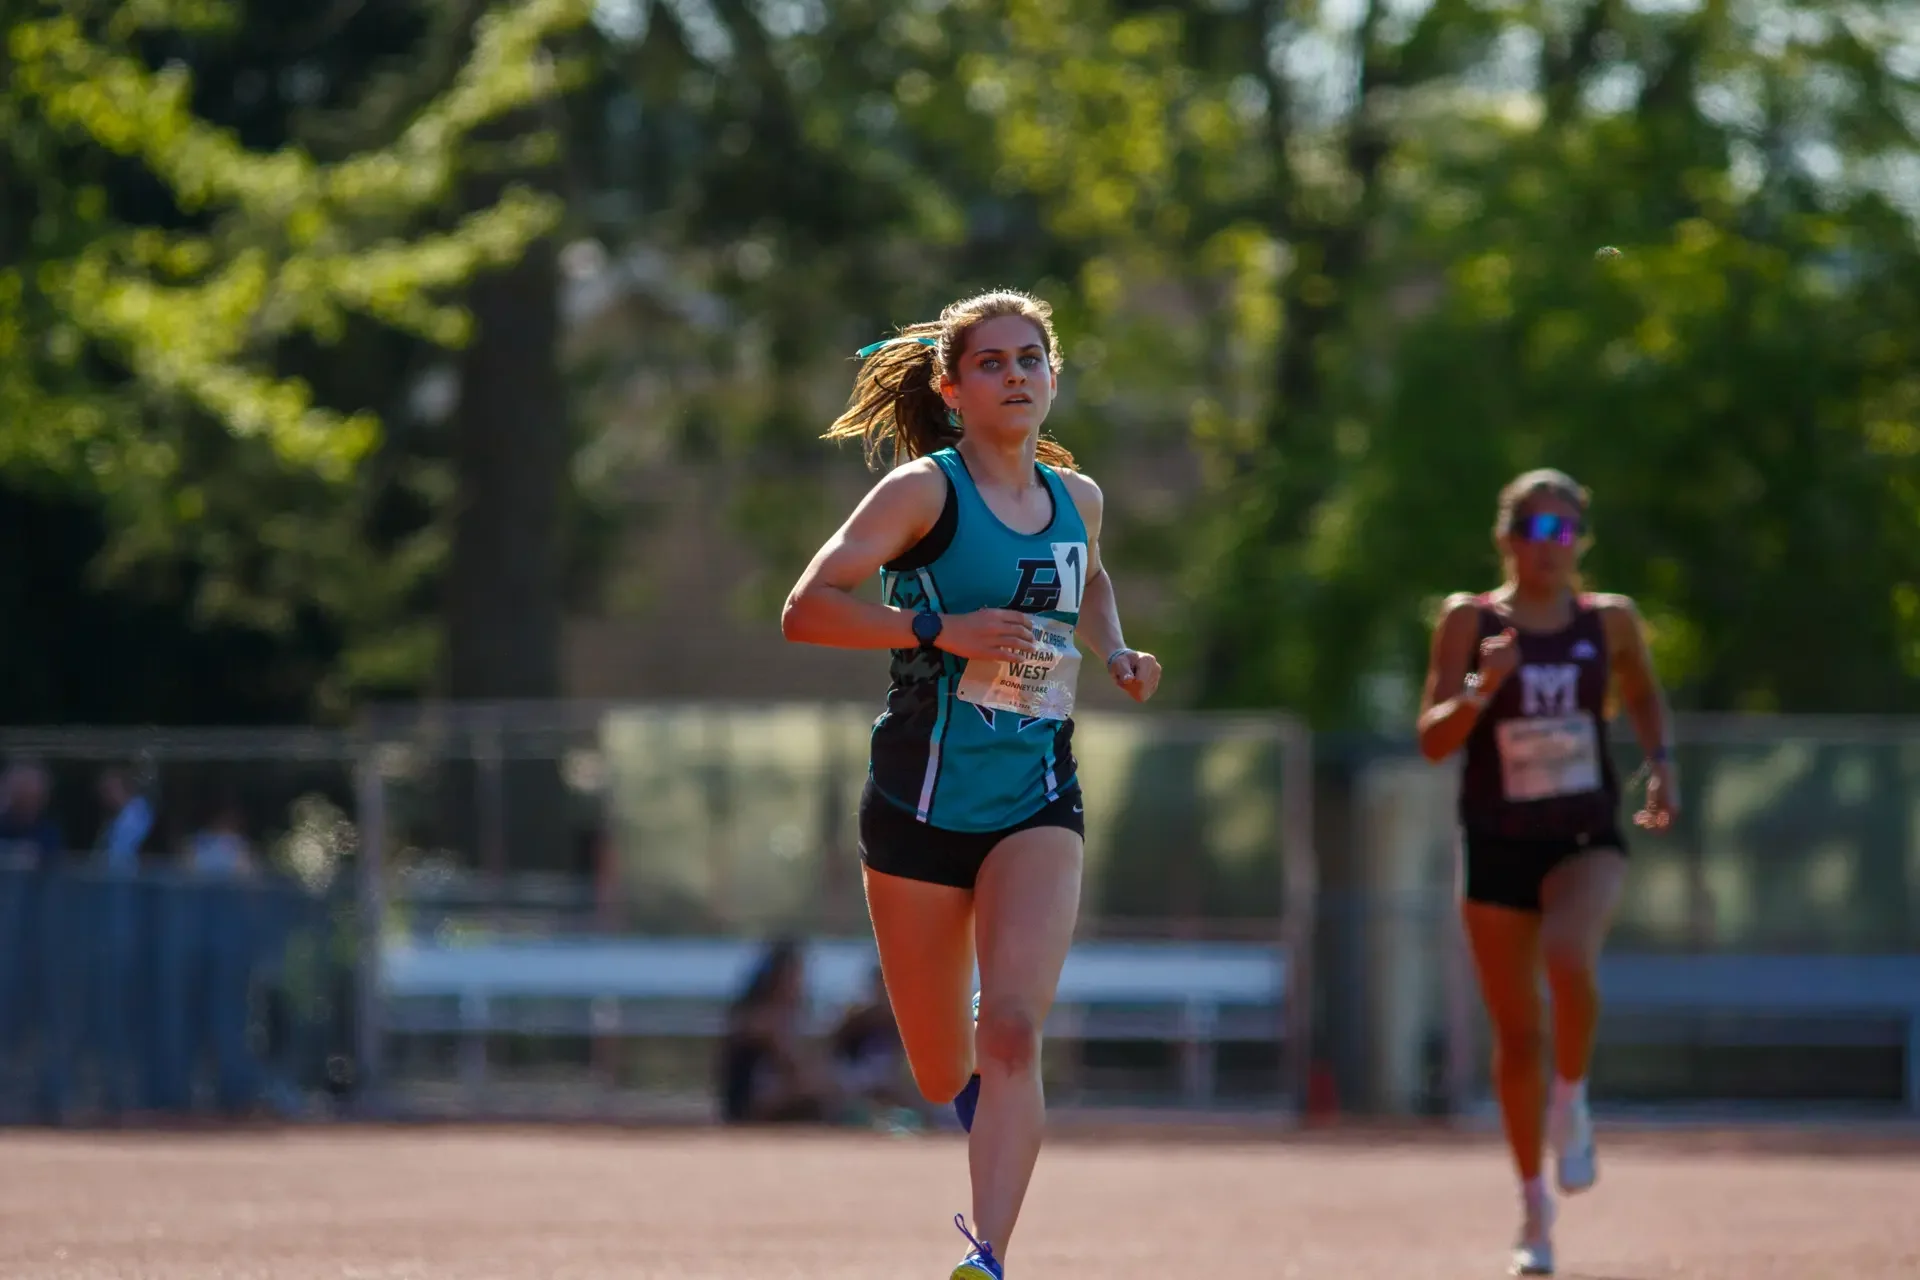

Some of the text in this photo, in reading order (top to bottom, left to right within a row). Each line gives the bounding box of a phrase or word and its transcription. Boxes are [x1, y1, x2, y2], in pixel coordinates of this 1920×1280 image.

[1065, 546, 1081, 609] 1
[1009, 661, 1050, 681] WEST
[1000, 679, 1049, 694] BONNEY LAKE
